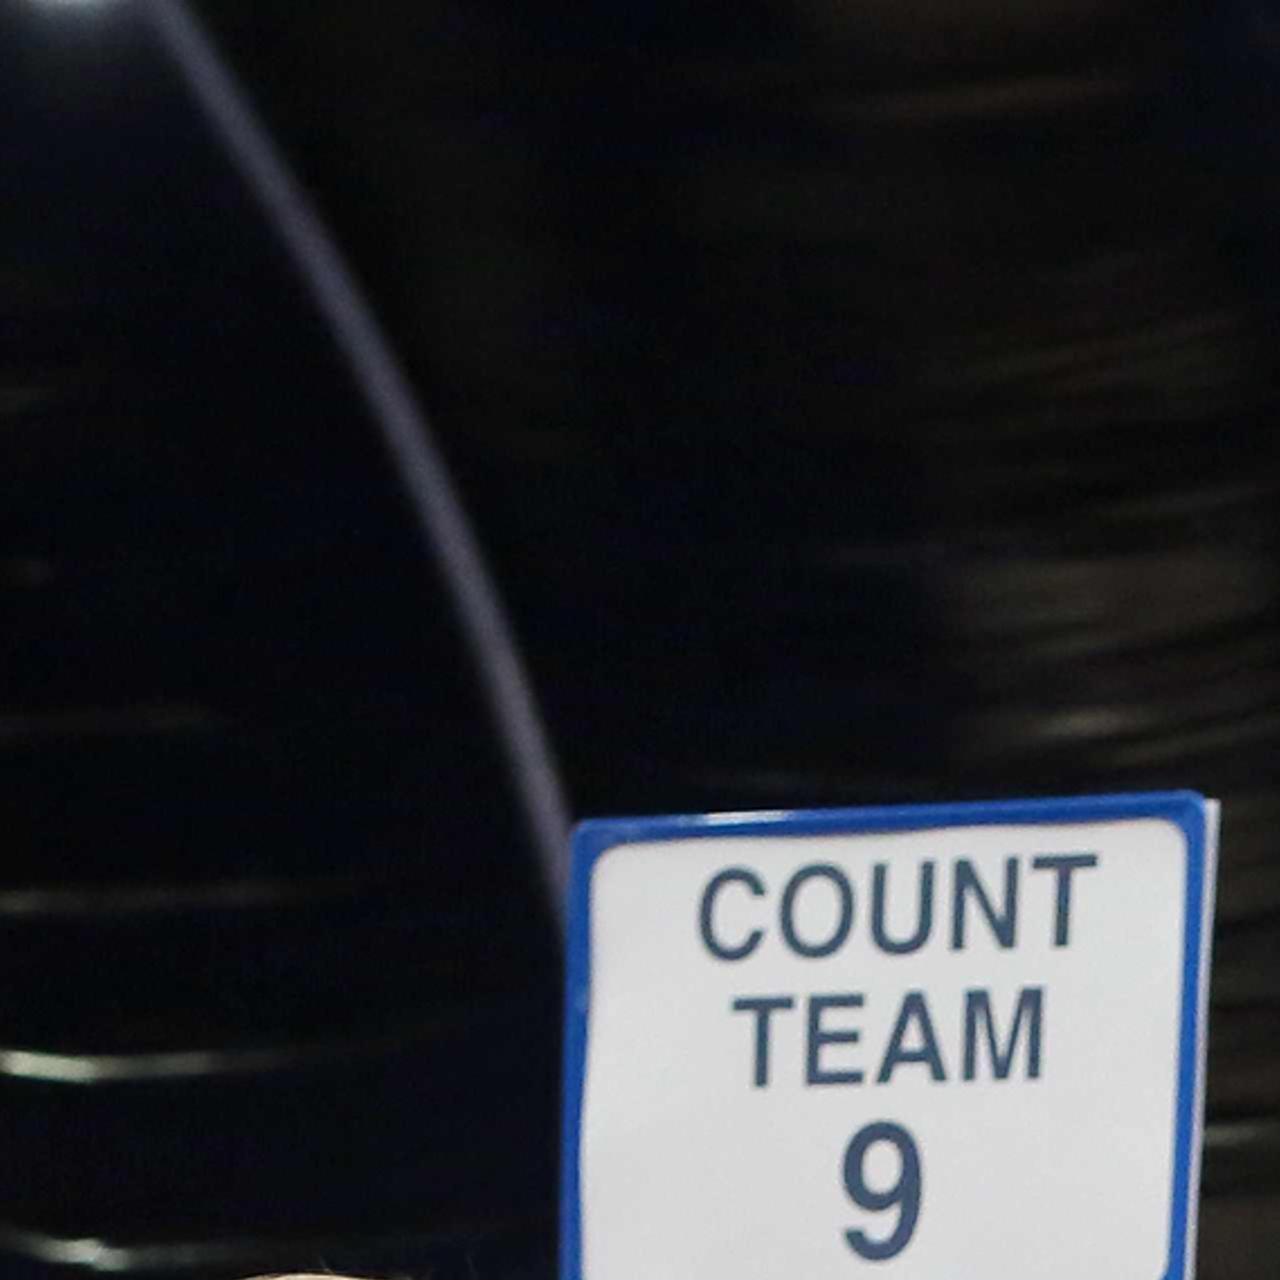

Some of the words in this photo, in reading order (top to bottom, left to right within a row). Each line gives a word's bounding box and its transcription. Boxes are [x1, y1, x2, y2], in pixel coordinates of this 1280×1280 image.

[699, 853, 1099, 962] COUNT
[732, 986, 1045, 1089] TEAM
[842, 1121, 923, 1261] 9
